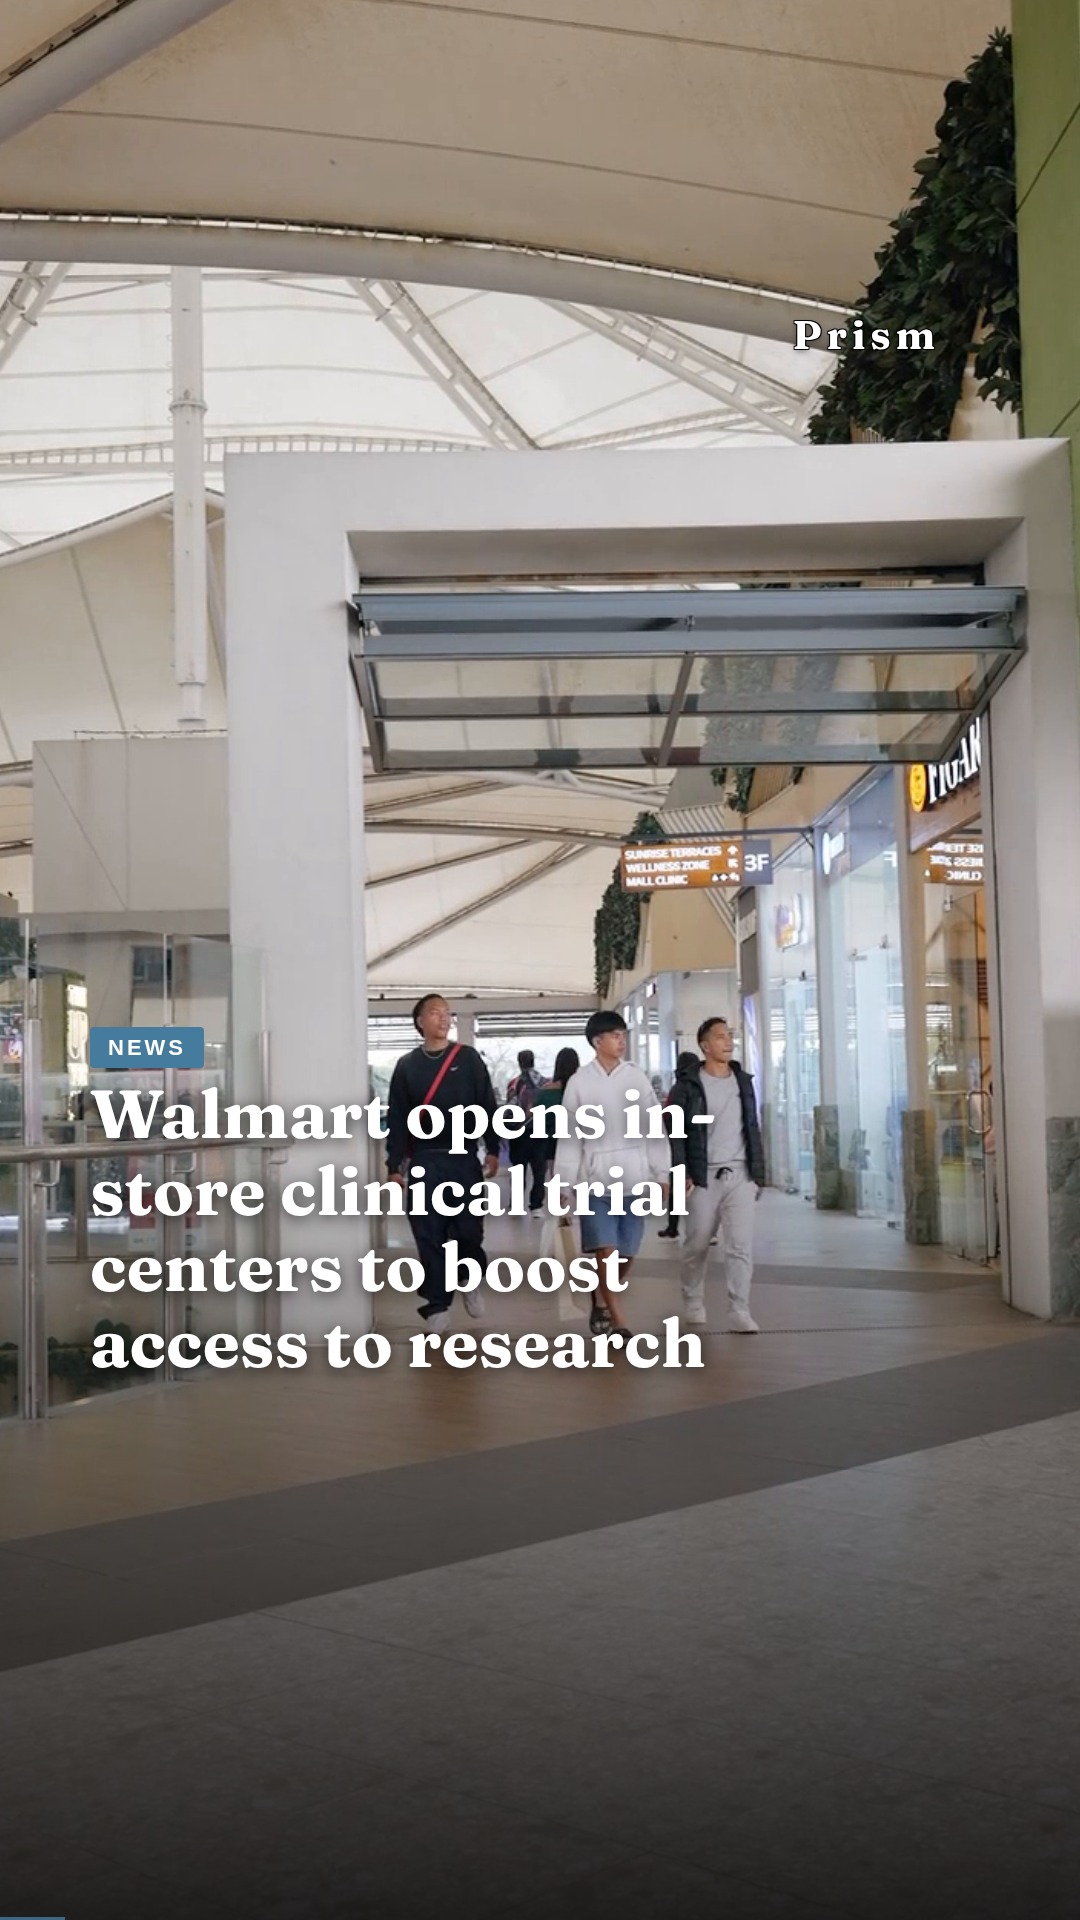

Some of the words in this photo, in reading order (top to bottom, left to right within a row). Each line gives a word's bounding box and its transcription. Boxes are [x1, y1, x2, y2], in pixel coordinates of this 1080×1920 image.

[624, 849, 669, 860] SUNRISE
[671, 846, 722, 857] TERRACES
[625, 862, 681, 873] WELLNESS
[682, 860, 710, 870] ZONE
[744, 854, 769, 872] 3F
[626, 876, 654, 887] MALL
[655, 875, 688, 885] CLINIC
